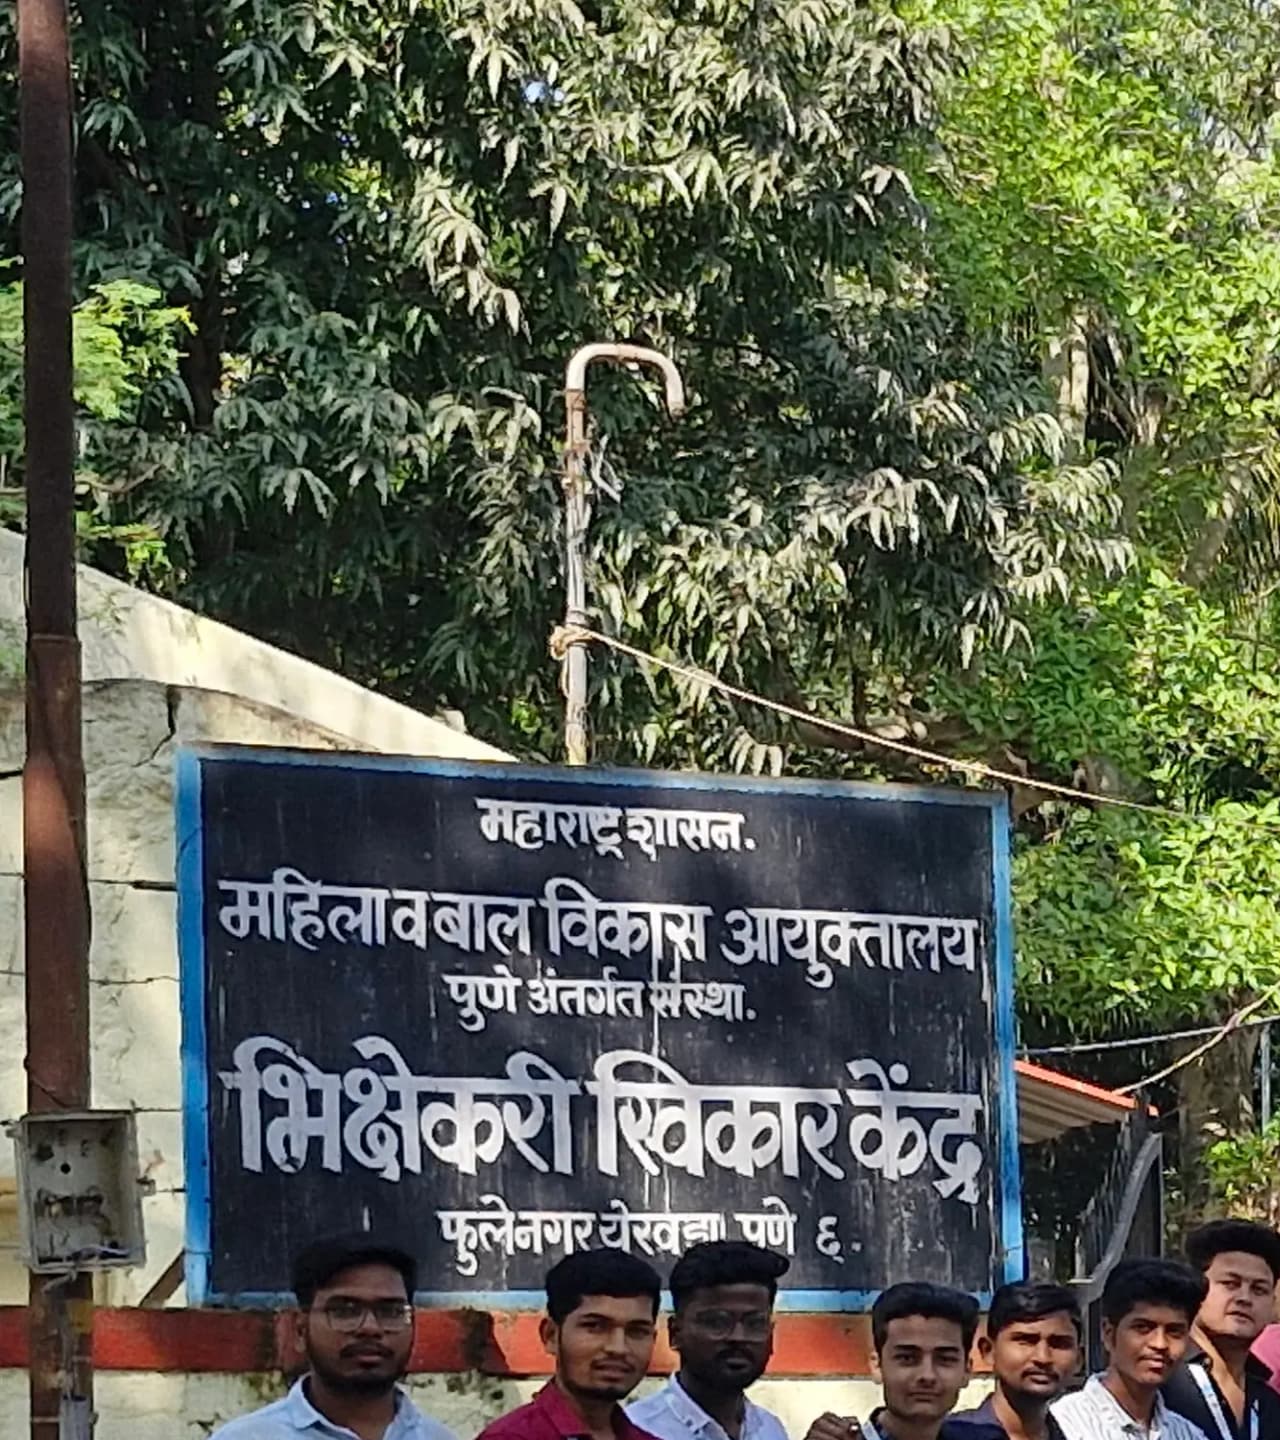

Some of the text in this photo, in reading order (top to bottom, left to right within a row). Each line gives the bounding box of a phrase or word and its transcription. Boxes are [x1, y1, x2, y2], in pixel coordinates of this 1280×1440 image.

[539, 877, 713, 961] विकास
[720, 906, 977, 989] आयुक्तालय
[442, 964, 522, 1032] पुणे
[527, 966, 644, 1018] अंतर्गत
[217, 1035, 580, 1182] भिक्षेकरी
[436, 1195, 596, 1276] फुलेनगर
